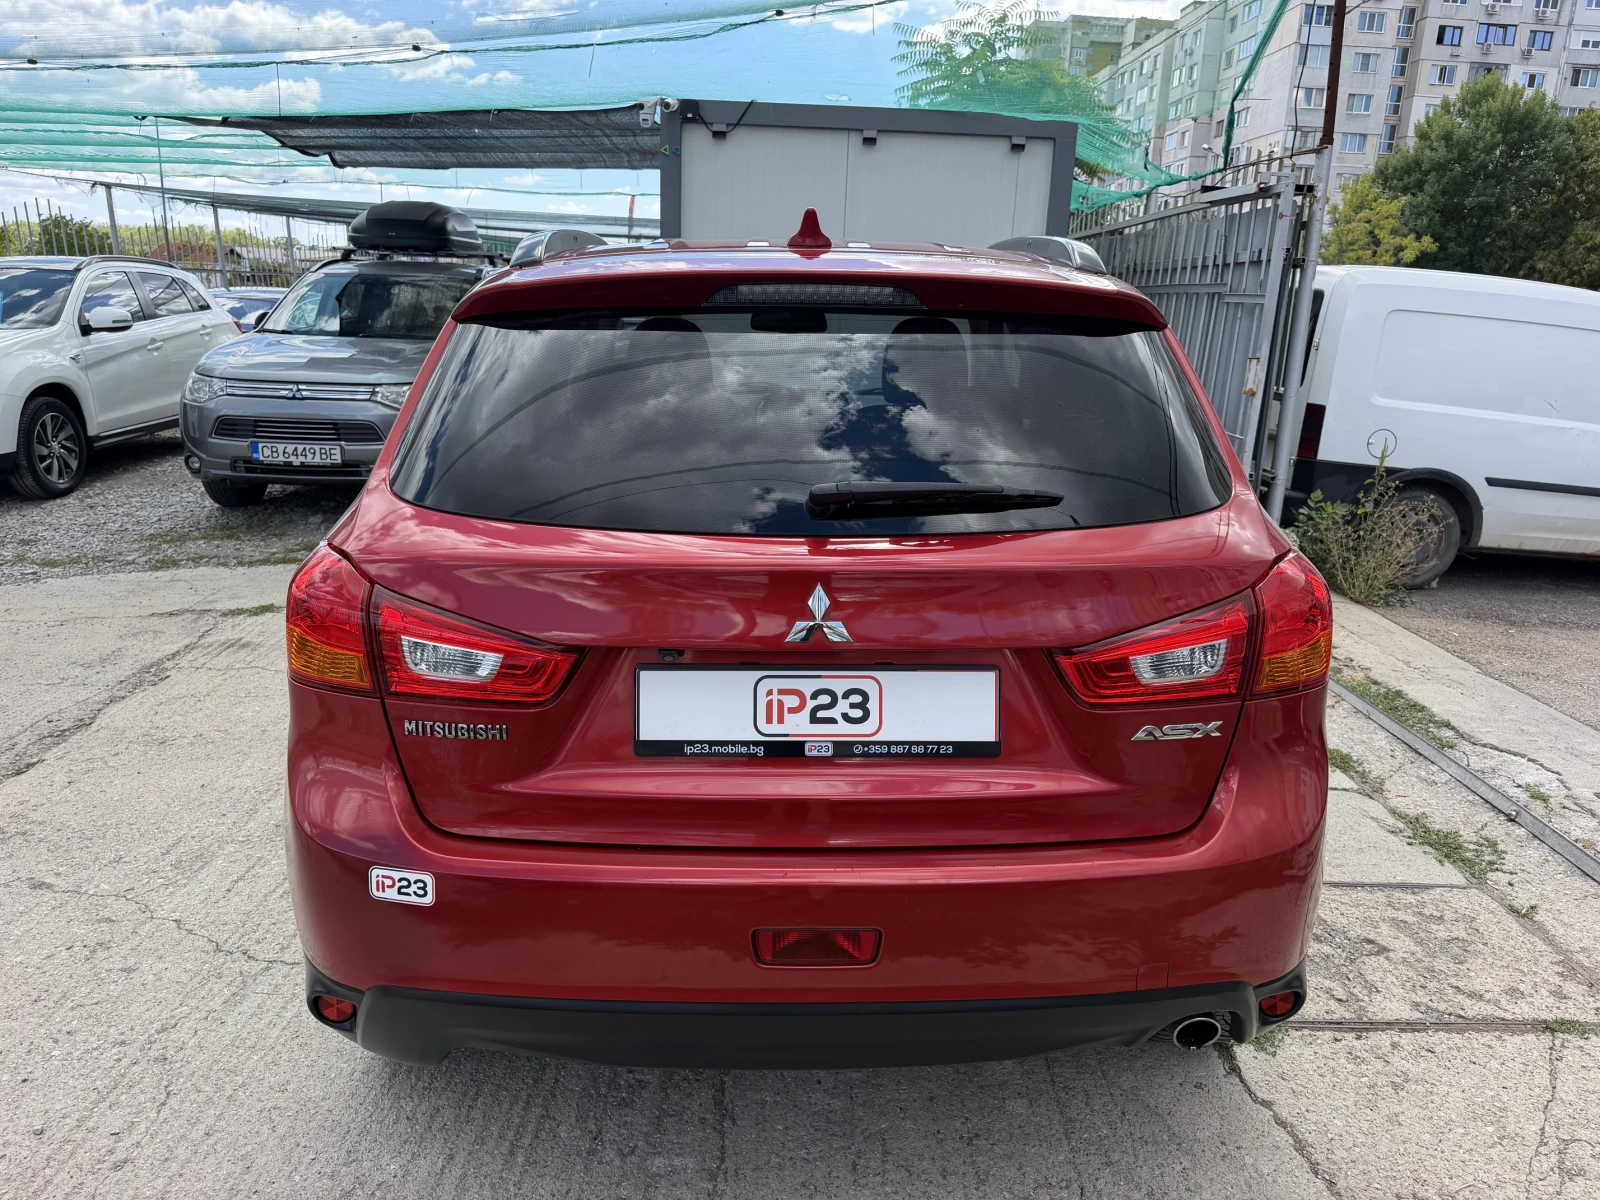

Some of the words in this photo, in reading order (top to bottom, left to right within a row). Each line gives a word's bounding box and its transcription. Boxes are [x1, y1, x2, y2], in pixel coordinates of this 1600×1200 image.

[261, 445, 280, 459] CB
[282, 445, 317, 460] 6449
[319, 447, 339, 461] BE
[404, 719, 508, 740] MITSUBISHI
[1130, 720, 1223, 741] ASX
[684, 743, 764, 756] ip23.mobile.bg
[864, 744, 888, 754] +359
[890, 744, 909, 754] 887
[911, 744, 925, 754] 88
[926, 744, 938, 754] 77
[939, 744, 953, 754] 23
